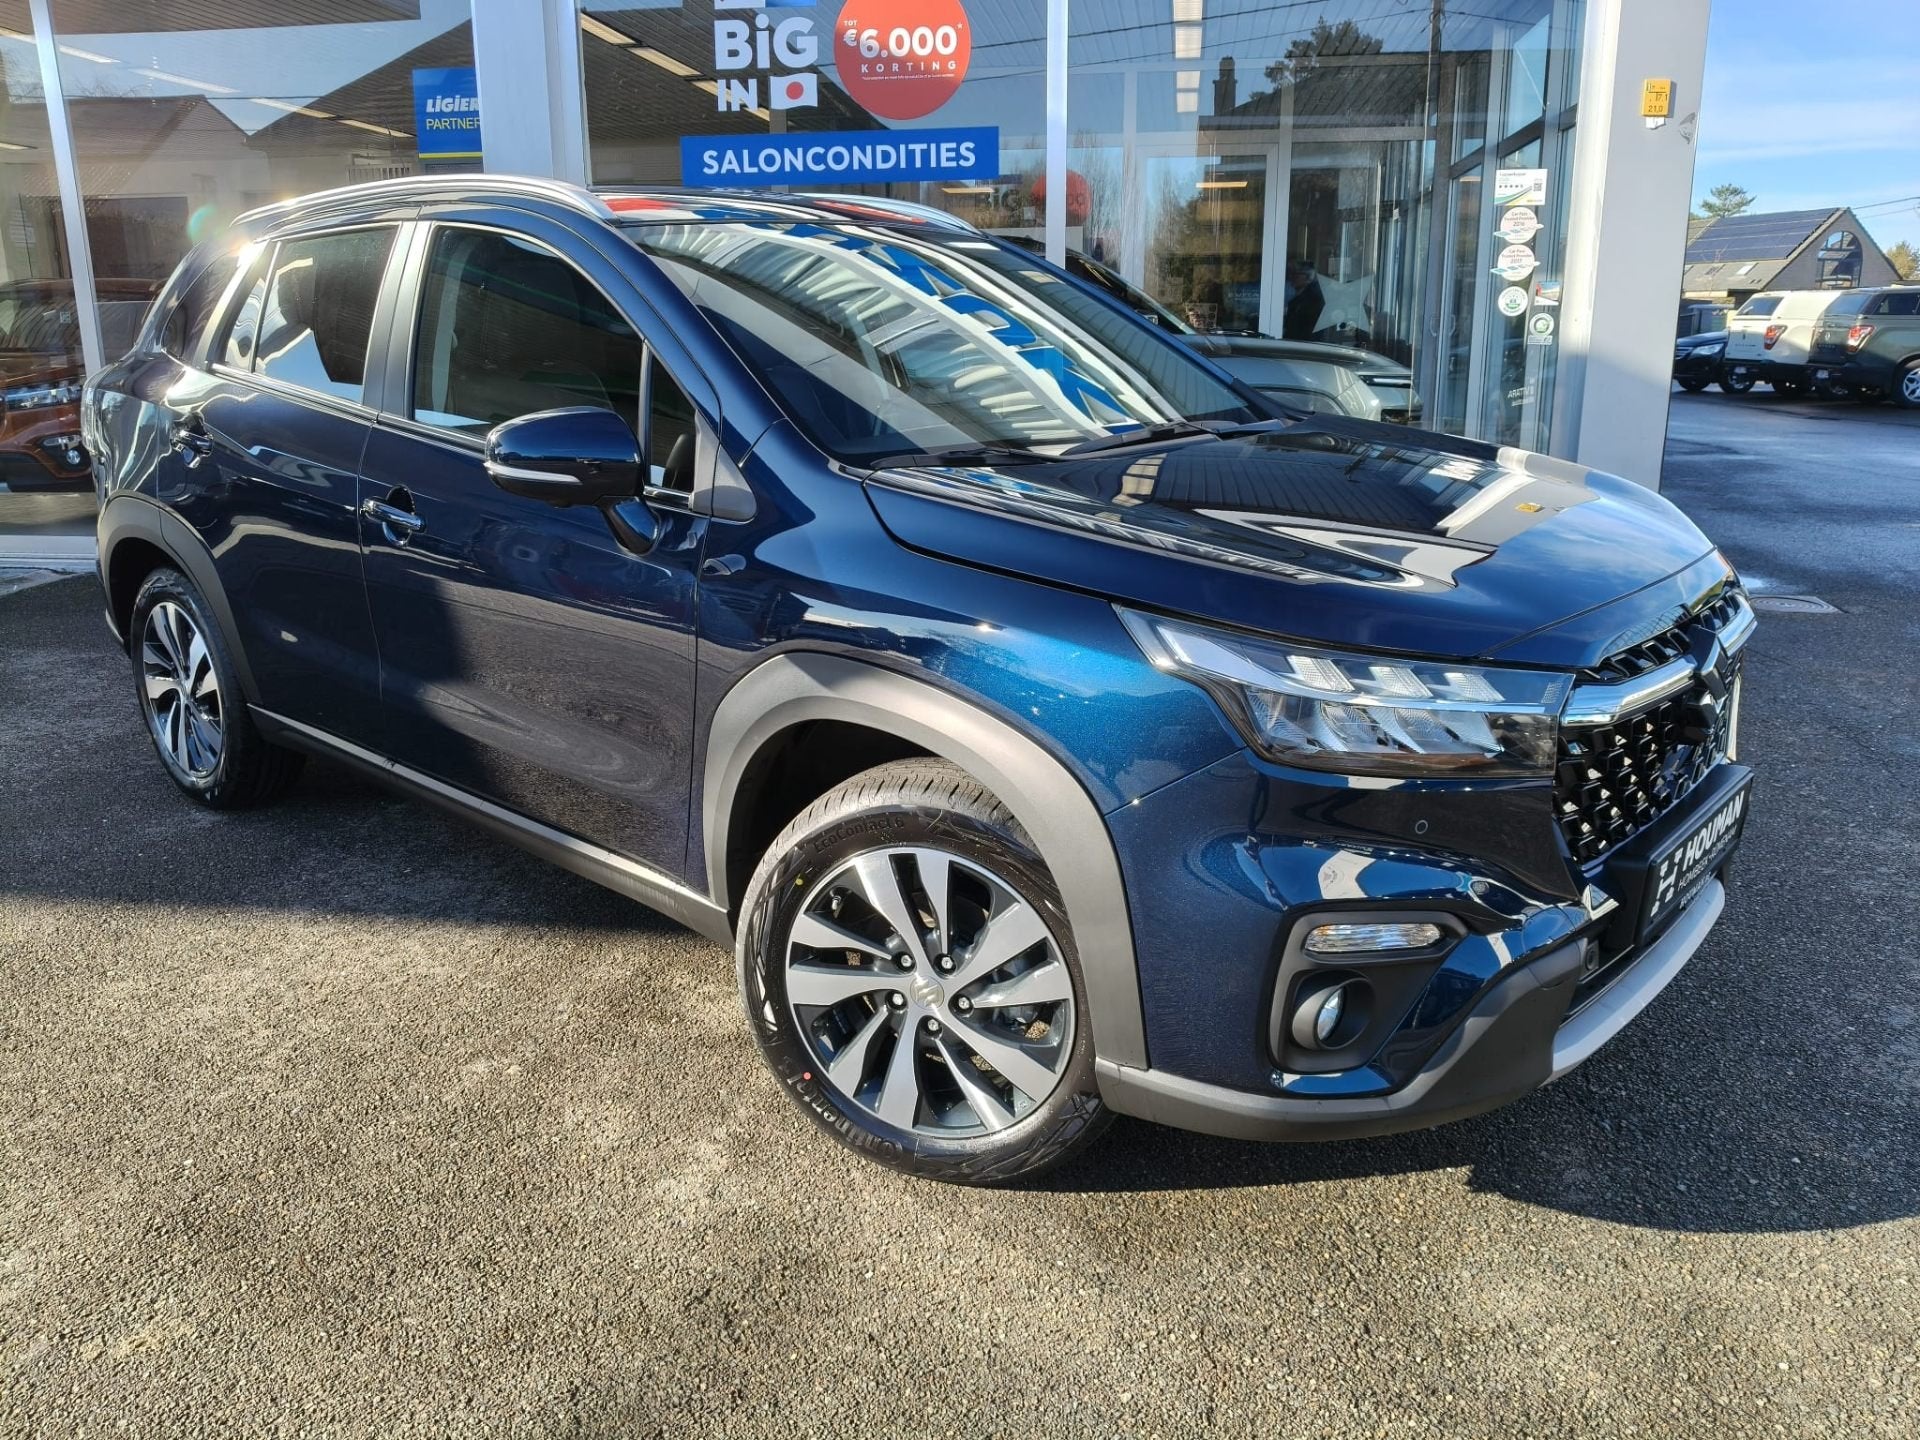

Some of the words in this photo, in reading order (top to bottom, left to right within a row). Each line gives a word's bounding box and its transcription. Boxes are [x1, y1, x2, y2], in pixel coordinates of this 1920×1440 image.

[861, 60, 956, 73] KORTING
[717, 78, 758, 112] IN
[703, 141, 977, 176] SALONCONDITIES
[1682, 790, 1745, 872] HOUMAN
